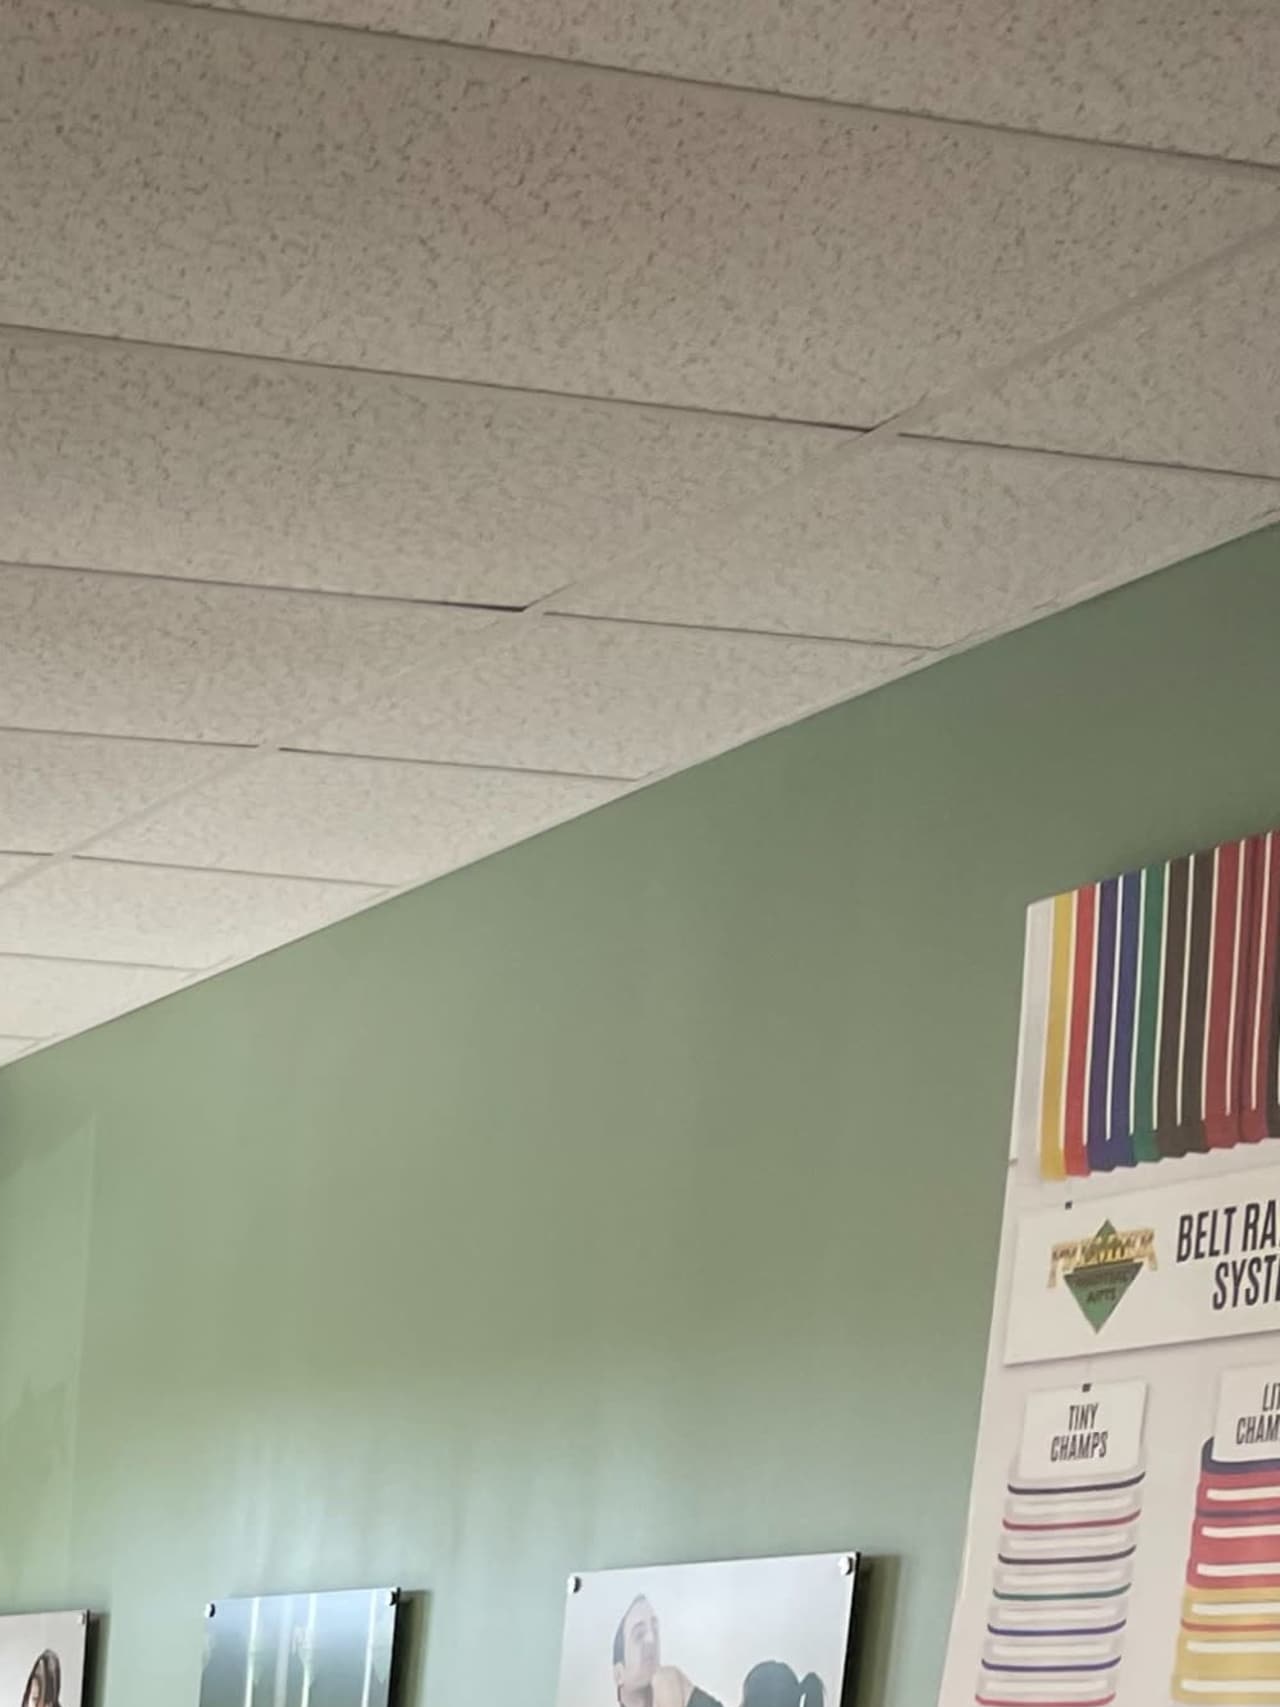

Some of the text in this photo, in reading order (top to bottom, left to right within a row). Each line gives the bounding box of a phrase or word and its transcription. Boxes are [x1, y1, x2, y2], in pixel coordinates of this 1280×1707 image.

[1176, 1206, 1237, 1263] BELT
[1241, 1199, 1280, 1252] RA
[1068, 1403, 1099, 1431] TINY
[1050, 1431, 1109, 1462] CHAMPS
